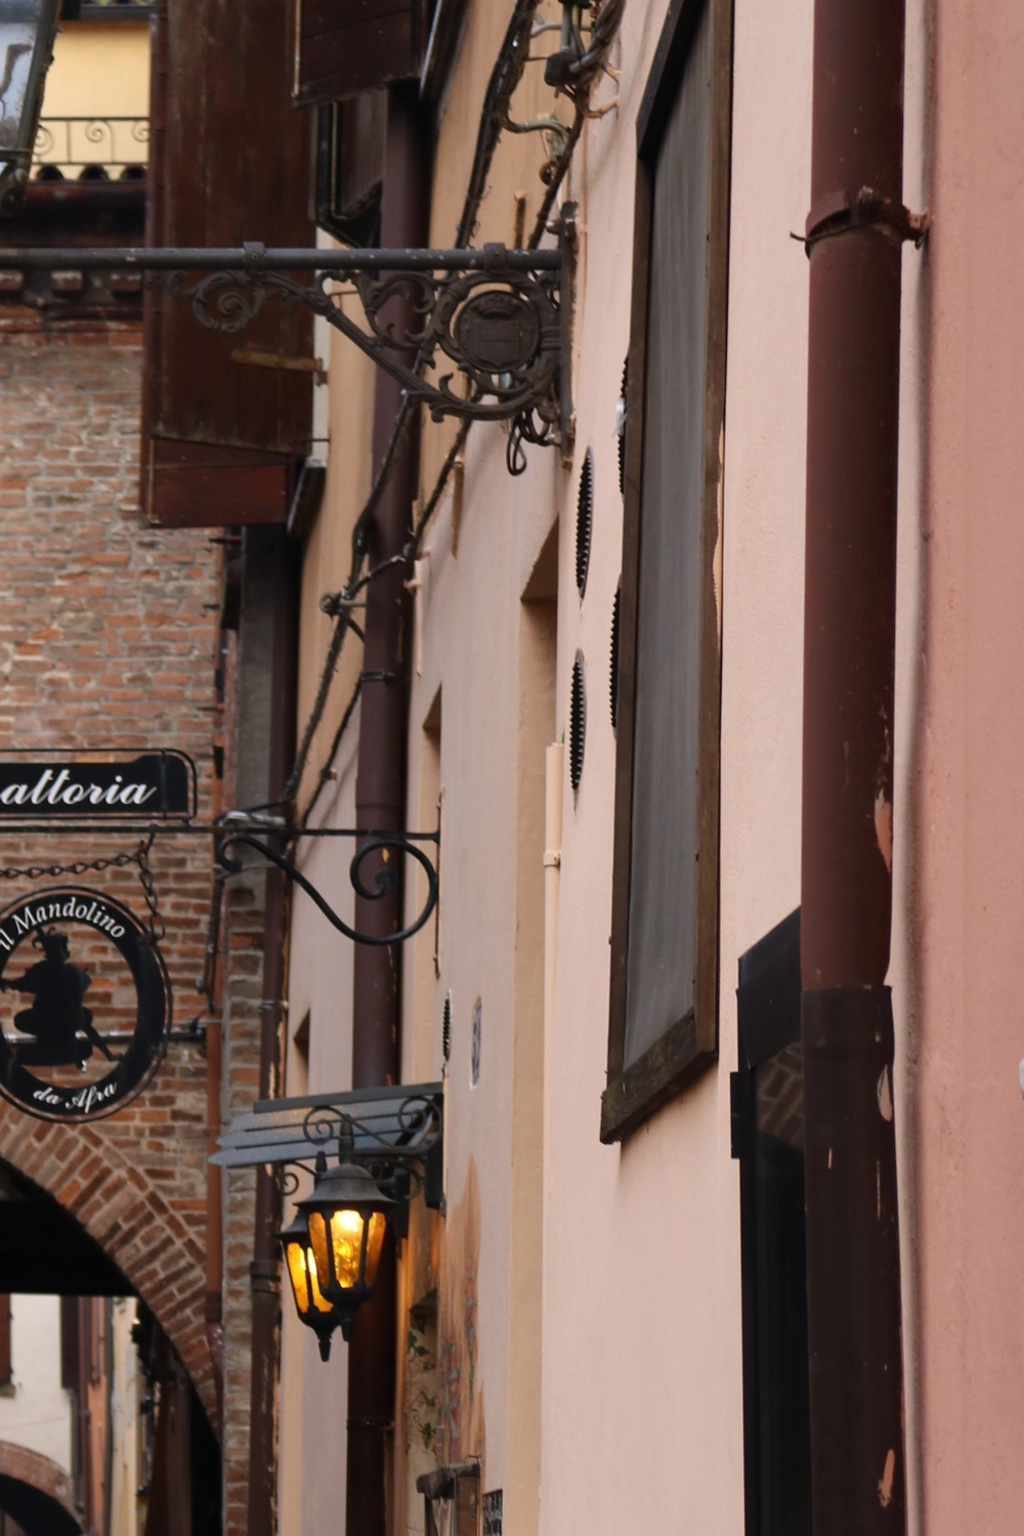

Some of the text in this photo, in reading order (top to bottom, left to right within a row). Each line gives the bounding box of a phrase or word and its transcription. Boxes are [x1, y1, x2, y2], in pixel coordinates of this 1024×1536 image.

[12, 897, 126, 939] Mandolino
[33, 1081, 117, 1113] da Afra
